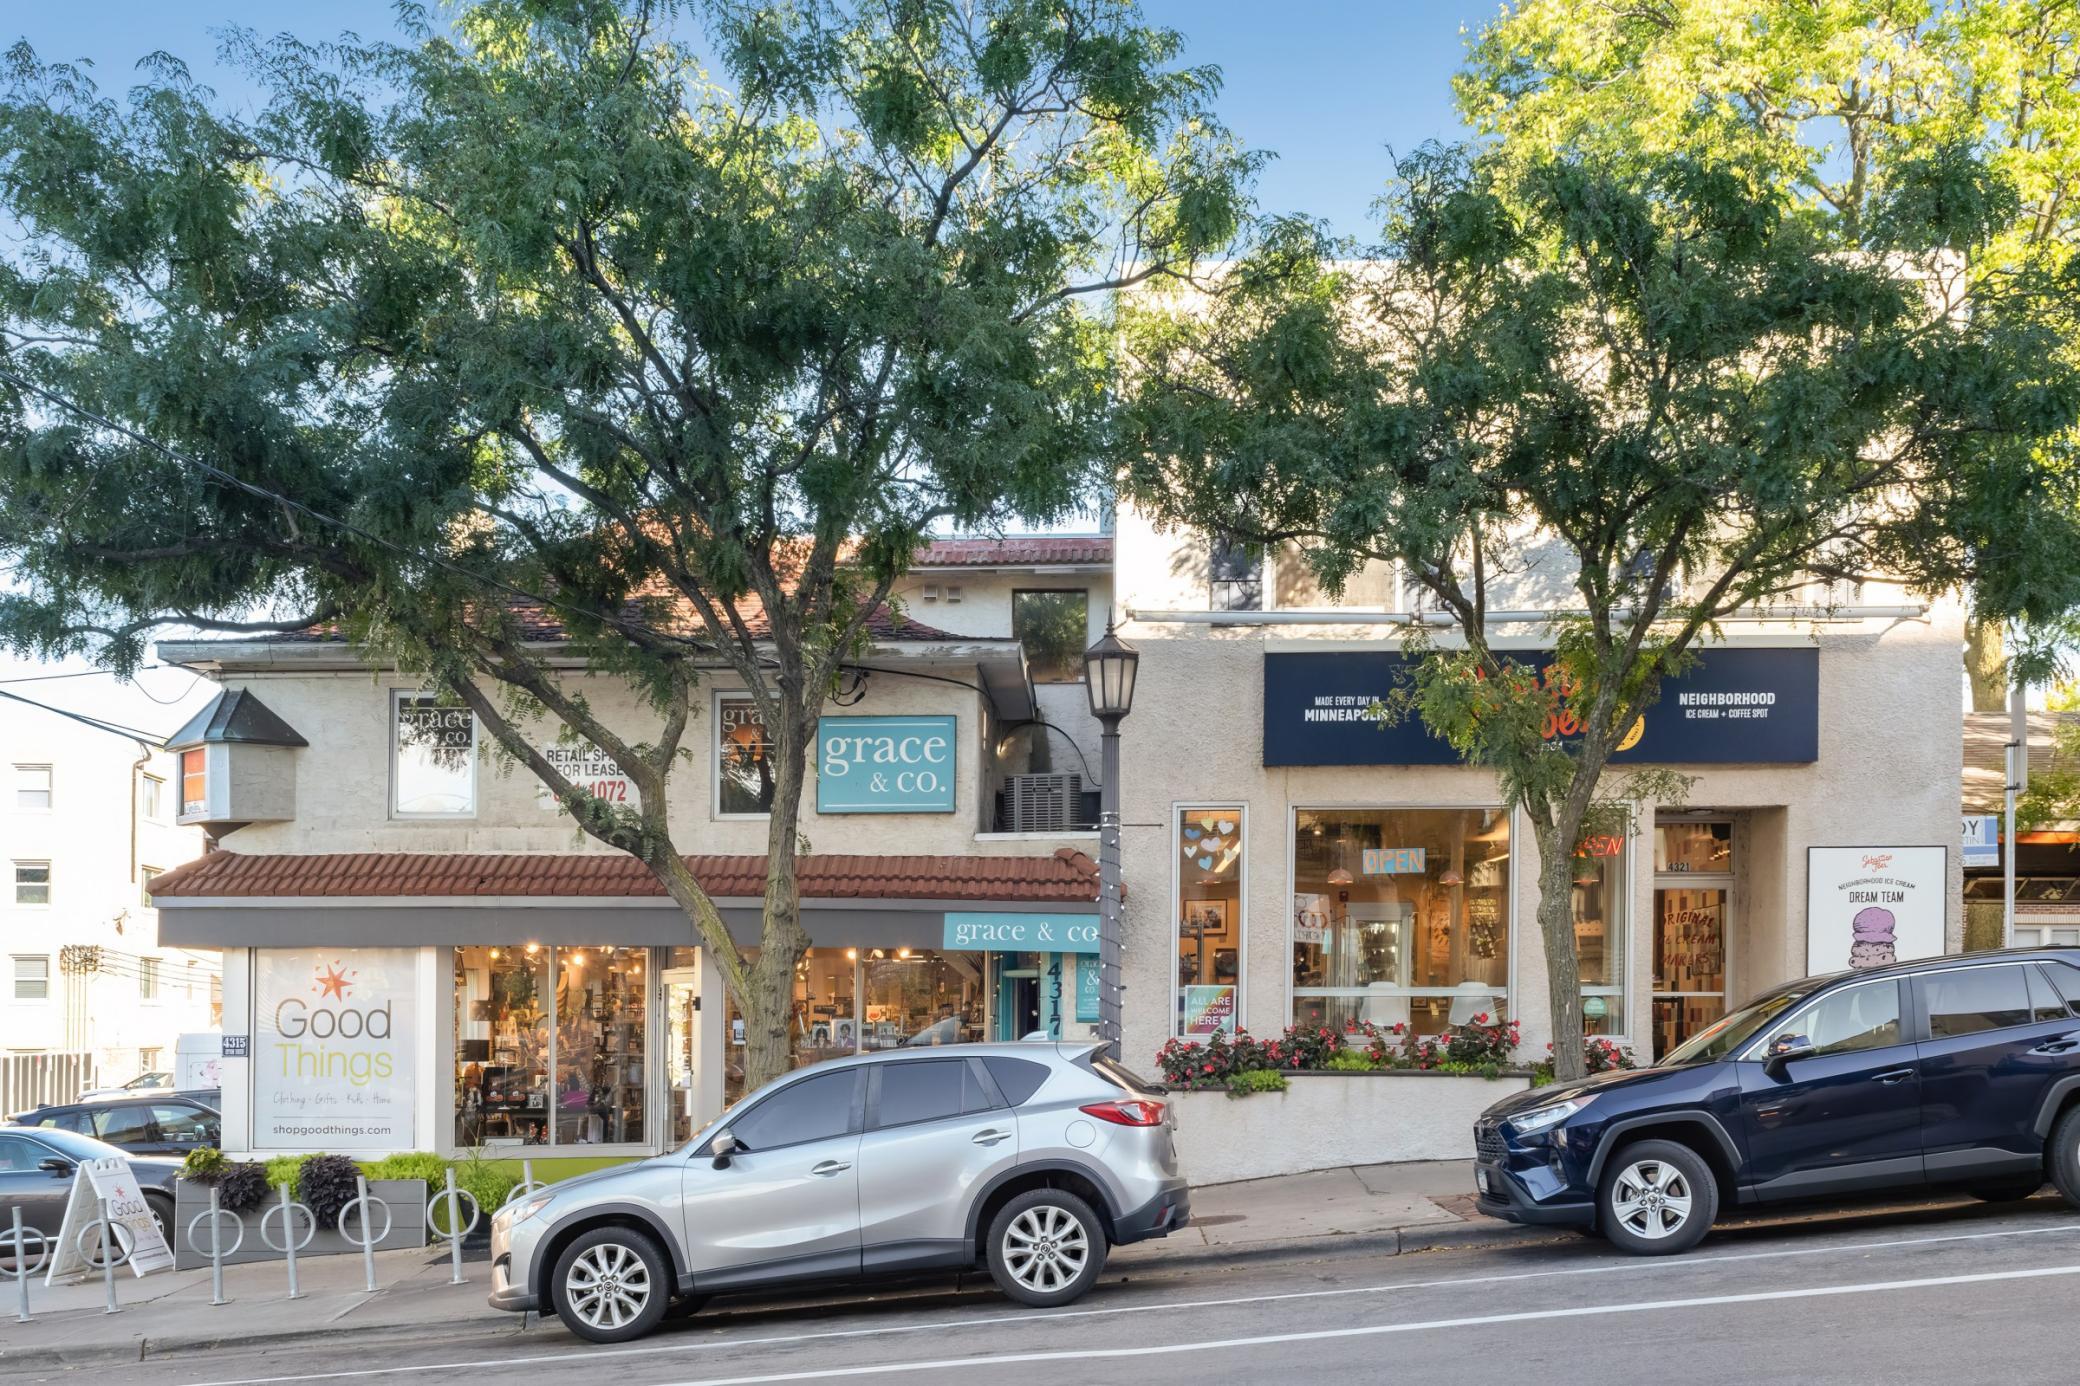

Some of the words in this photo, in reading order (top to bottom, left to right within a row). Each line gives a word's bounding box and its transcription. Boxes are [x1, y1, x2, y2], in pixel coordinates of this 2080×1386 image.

[1314, 696, 1333, 706] MADE
[1335, 696, 1355, 706] EVERY
[1357, 696, 1370, 706] DAY
[1679, 692, 1776, 705] NEIGHBORHOOD
[1685, 709, 1696, 719] ICE
[1697, 709, 1719, 719] CREAM
[1728, 708, 1751, 718] COFFEE
[1752, 708, 1768, 718] SPOT
[546, 748, 589, 762] RETAIL
[825, 736, 946, 777] grace
[870, 772, 890, 793] &
[897, 771, 947, 793] co.
[1364, 848, 1424, 873] OPEN
[1668, 862, 1690, 873] 4321
[1884, 877, 1894, 885] ICE
[1895, 879, 1916, 889] CREAM
[1849, 891, 1878, 903] DREAM
[1882, 891, 1904, 903] TEAM
[955, 923, 1025, 945] grace
[1037, 921, 1055, 942] &
[1047, 961, 1062, 1036] 4317
[1210, 996, 1231, 1006] ARE
[275, 998, 392, 1039] Good
[1190, 1016, 1219, 1025] HERE
[223, 1037, 246, 1049] 4315
[273, 1043, 393, 1087] Things
[272, 1124, 392, 1137] shopgoodthings.com
